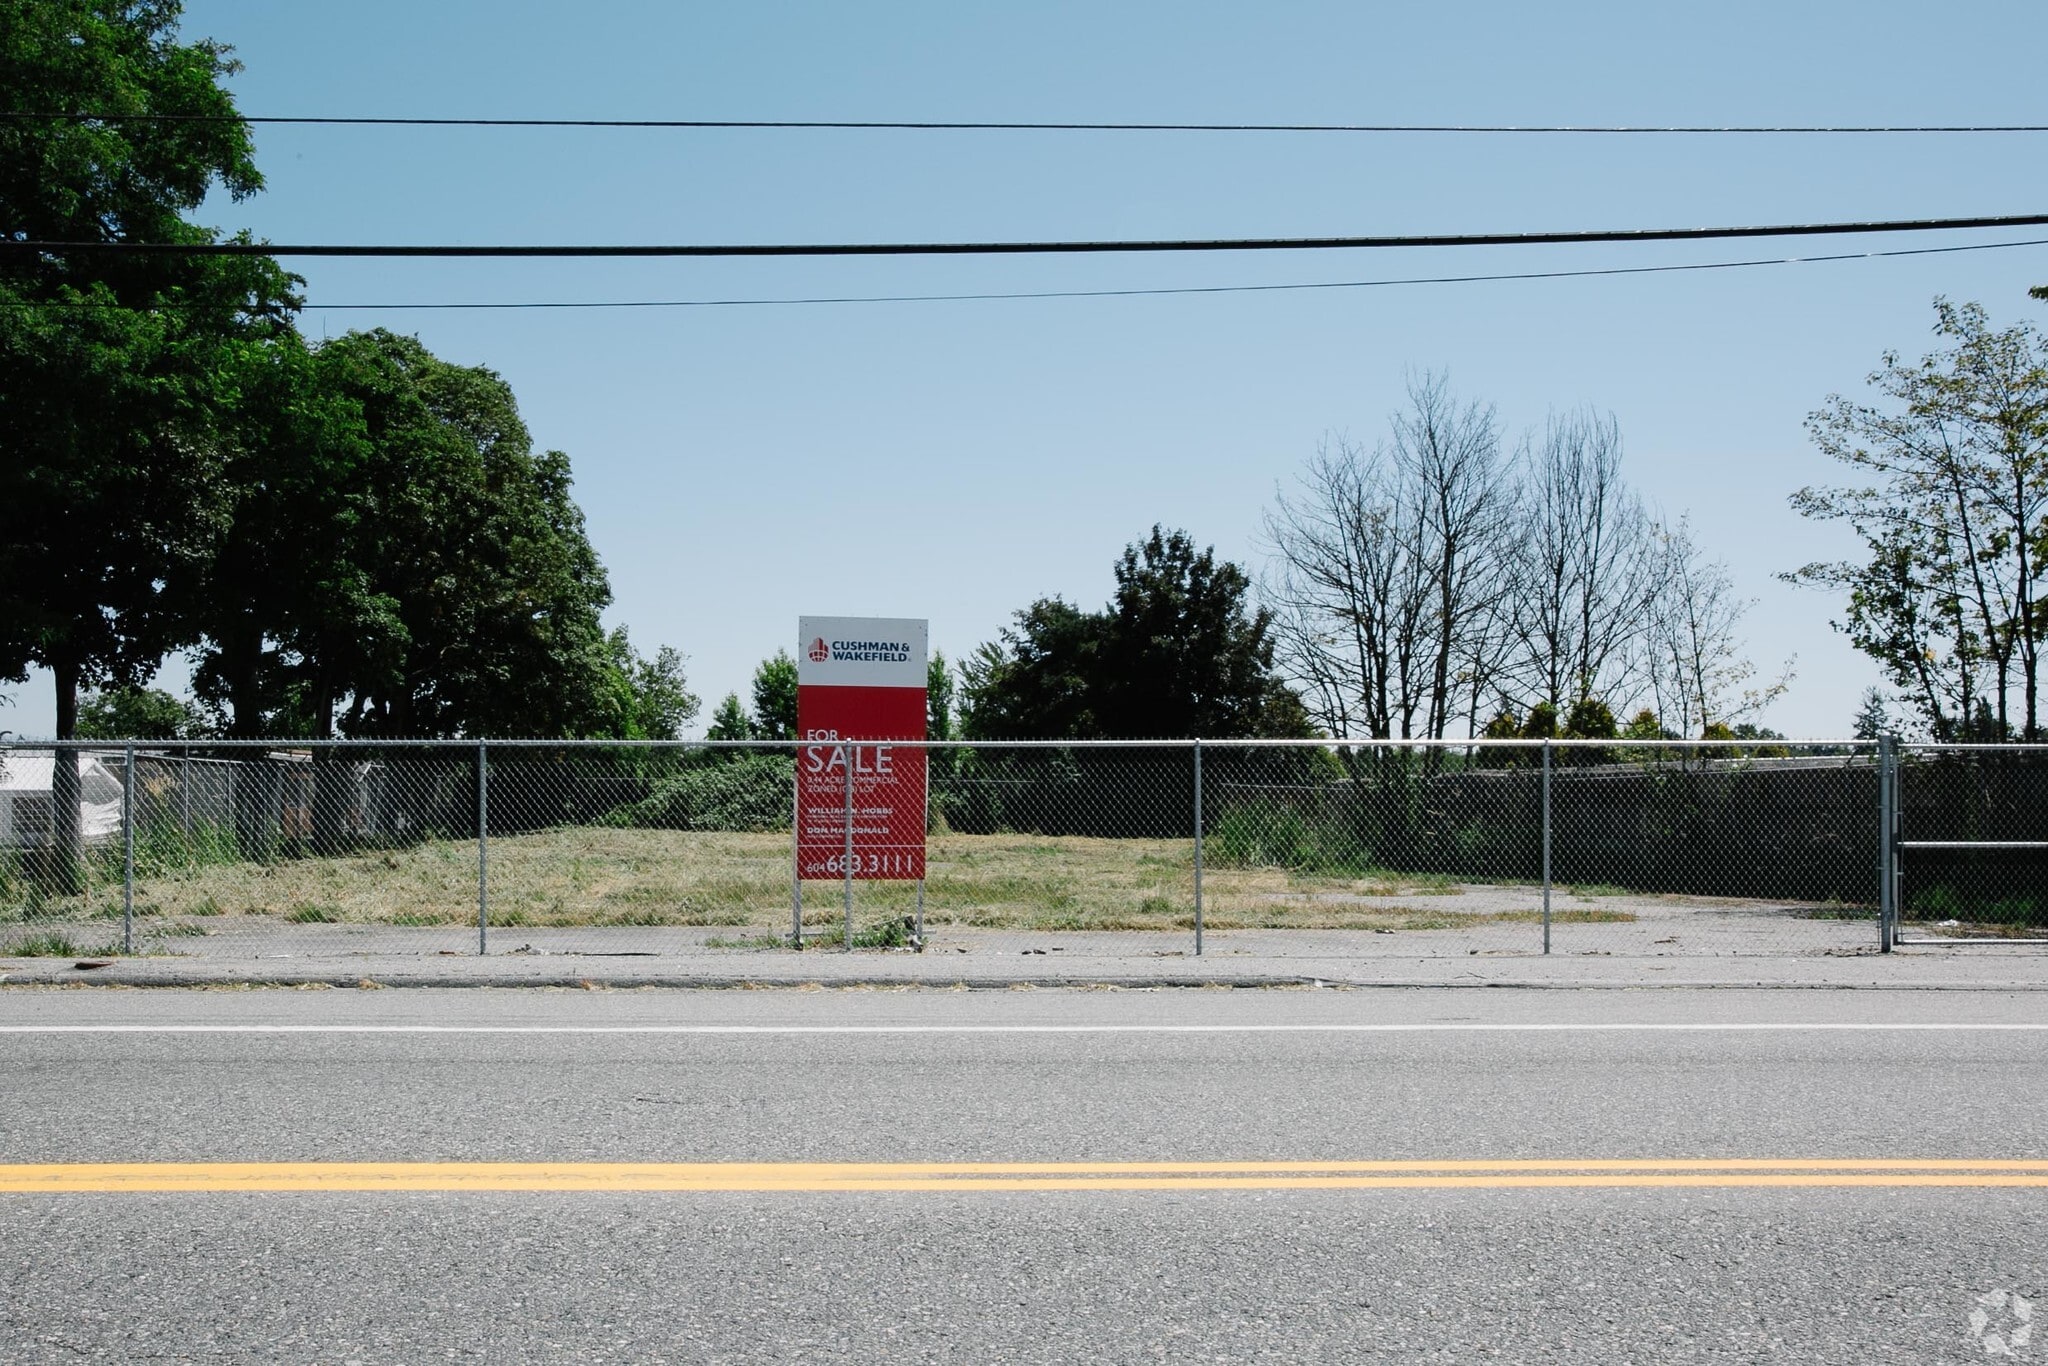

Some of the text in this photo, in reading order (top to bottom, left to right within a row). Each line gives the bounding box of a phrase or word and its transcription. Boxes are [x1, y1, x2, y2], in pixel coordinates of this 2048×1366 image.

[832, 640, 910, 652] CUSHMAN &
[832, 651, 907, 662] WAKEFIELD
[807, 729, 839, 742] FOR
[807, 745, 893, 773] SALE
[852, 776, 899, 784] OMMERCIAL
[806, 854, 912, 873] 604 683.3111
